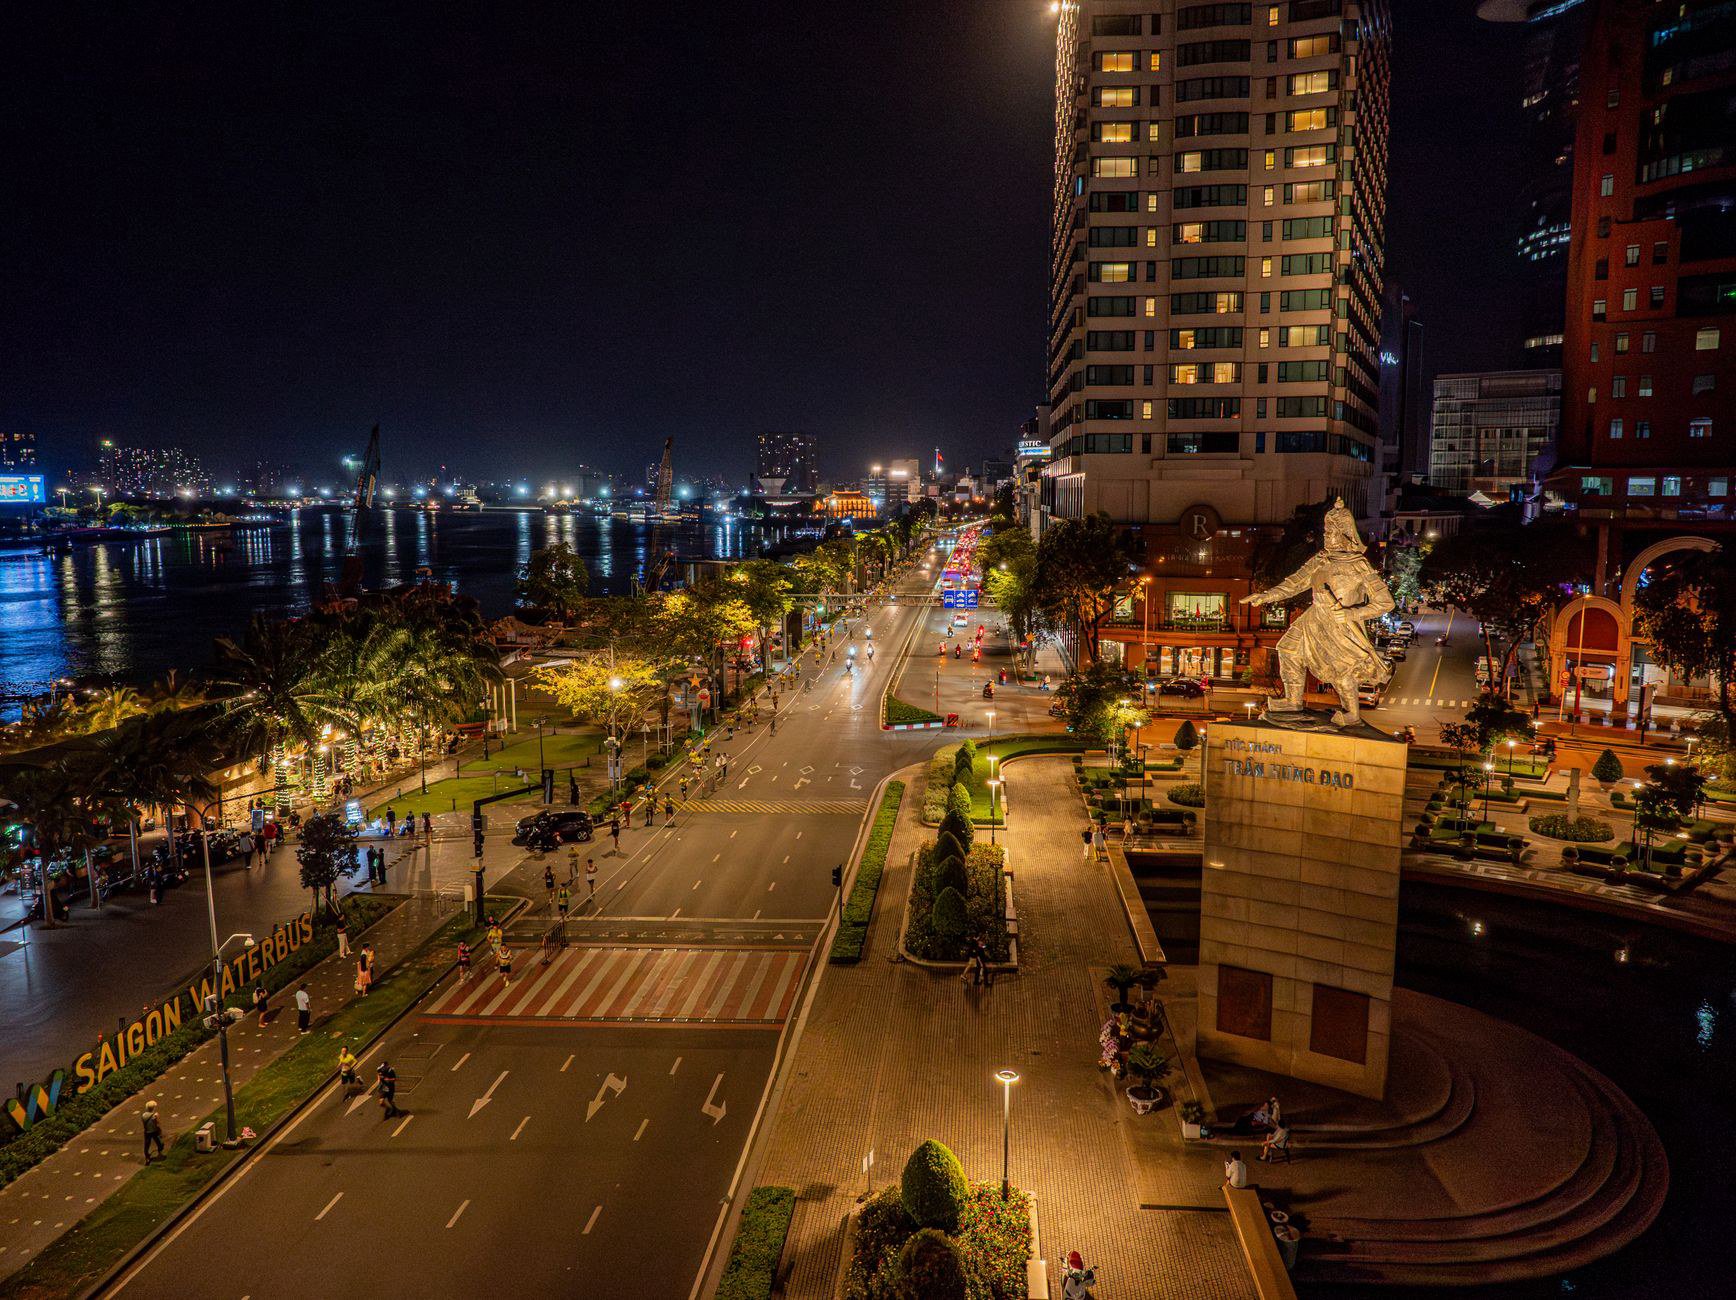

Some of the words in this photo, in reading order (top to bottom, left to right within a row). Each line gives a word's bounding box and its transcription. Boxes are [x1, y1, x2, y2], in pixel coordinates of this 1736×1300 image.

[1193, 514, 1210, 535] R
[75, 996, 181, 1094] SAIGON
[190, 912, 313, 1014] WATERBUS
